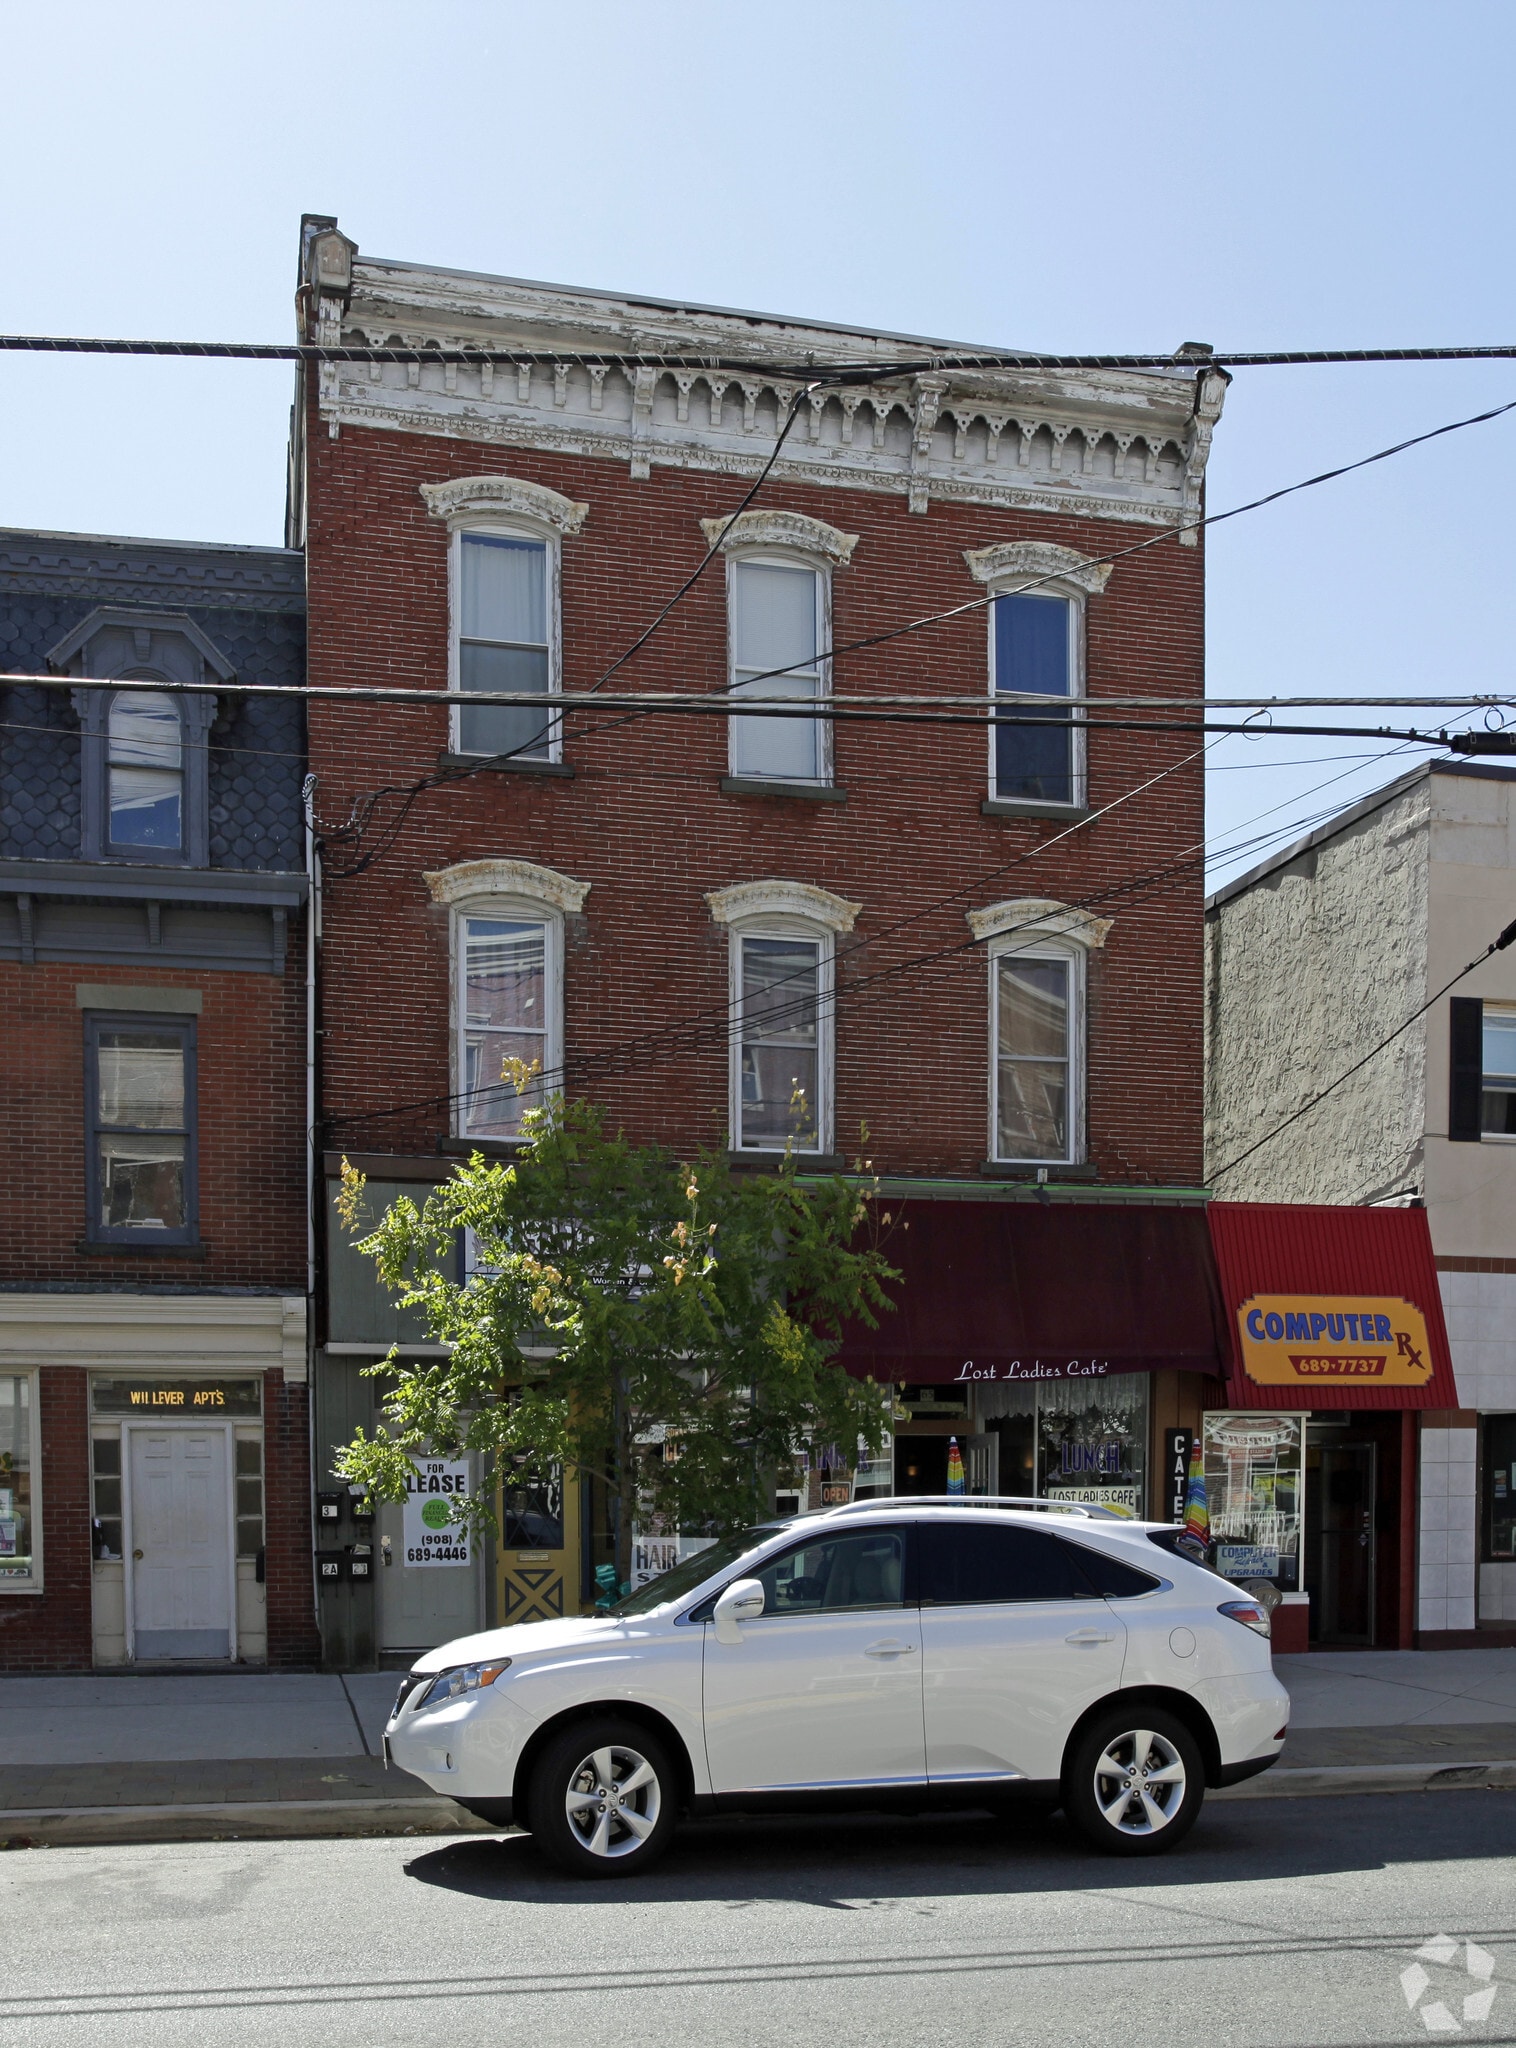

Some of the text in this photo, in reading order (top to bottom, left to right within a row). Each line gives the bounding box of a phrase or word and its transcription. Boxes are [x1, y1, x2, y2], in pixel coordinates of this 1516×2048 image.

[1246, 1308, 1394, 1342] COMPUTER
[954, 1361, 997, 1381] Lost
[1002, 1360, 1062, 1379] Ladies
[1062, 1440, 1120, 1474] LUNCH
[427, 1463, 444, 1473] FOR
[406, 1474, 465, 1493] LEASE
[823, 1487, 849, 1502] OPEN
[1053, 1489, 1134, 1506] LOST LADIES CAFE
[421, 1534, 453, 1546] (908)
[407, 1547, 467, 1562] 689-4446
[636, 1544, 677, 1569] HAIR
[1221, 1547, 1277, 1558] COMPUTER
[323, 1564, 337, 1575] 2A
[1224, 1568, 1273, 1576] UPGRADES
